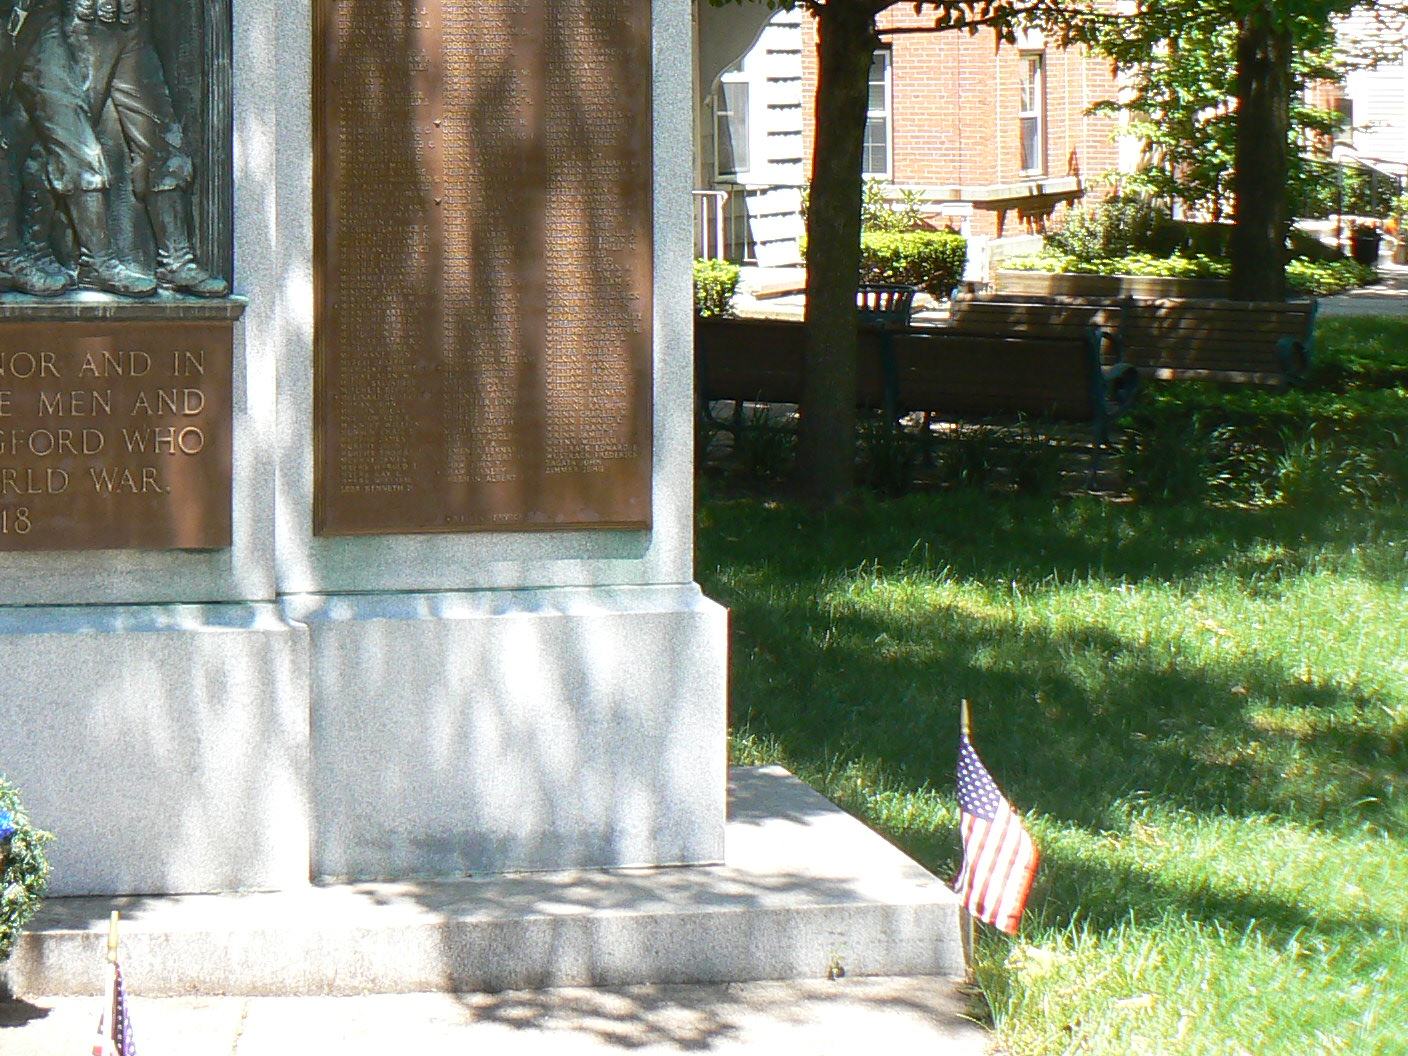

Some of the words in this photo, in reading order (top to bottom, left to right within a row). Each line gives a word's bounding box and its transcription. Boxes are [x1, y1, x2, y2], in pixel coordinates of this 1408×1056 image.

[78, 351, 152, 378] AND
[173, 350, 205, 376] IN
[38, 390, 112, 417] MEN
[130, 388, 206, 416] AND
[122, 426, 205, 455] WHO
[90, 466, 172, 494] WAR.
